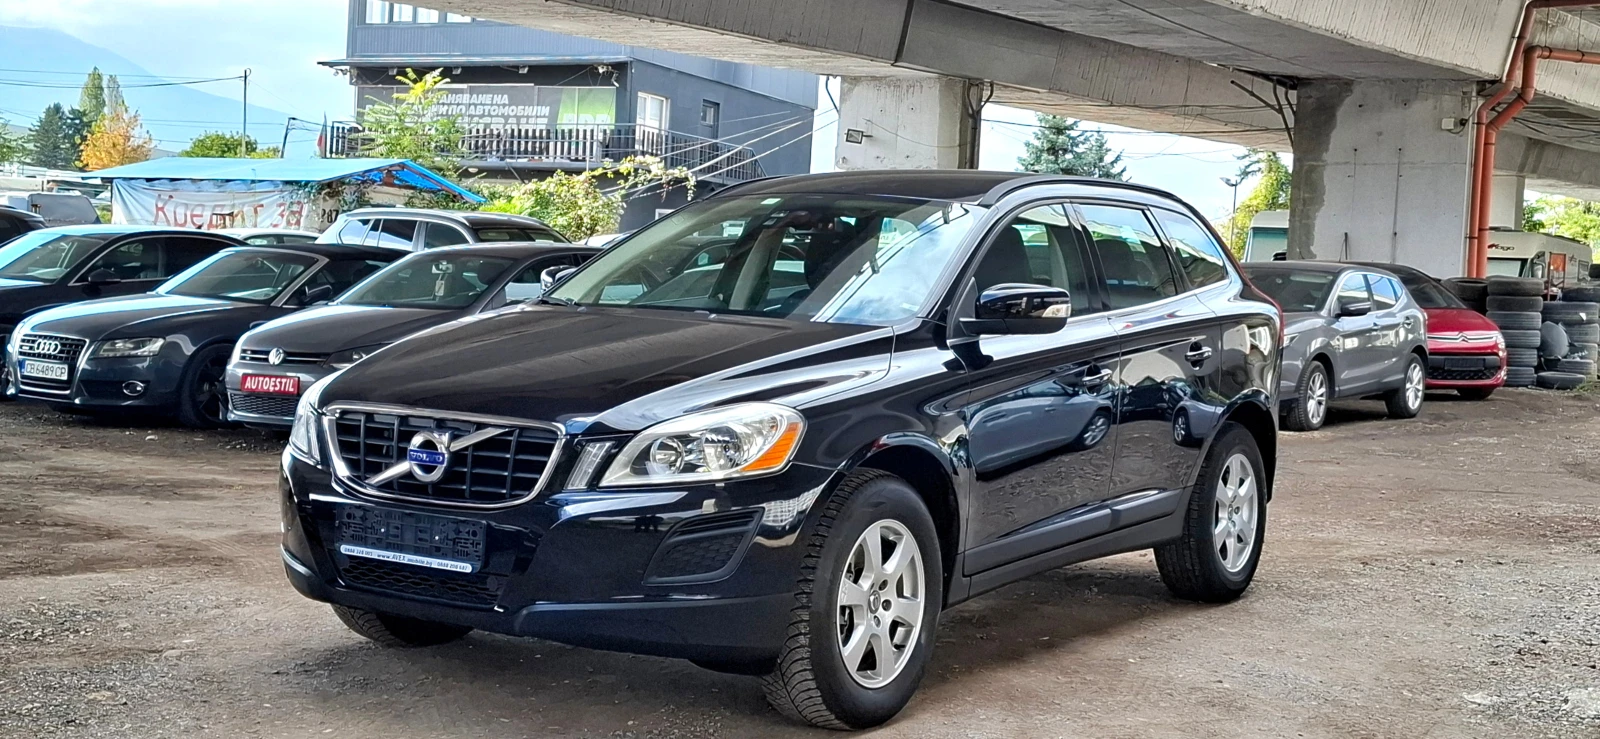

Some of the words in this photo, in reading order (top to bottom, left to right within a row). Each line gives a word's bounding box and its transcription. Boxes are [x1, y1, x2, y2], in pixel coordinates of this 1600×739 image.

[492, 94, 509, 105] НА
[448, 105, 466, 115] ПО
[468, 105, 550, 117] АВТОМОБИЛИ
[245, 376, 294, 393] AUTOESTIL
[410, 451, 443, 462] VOLVO
